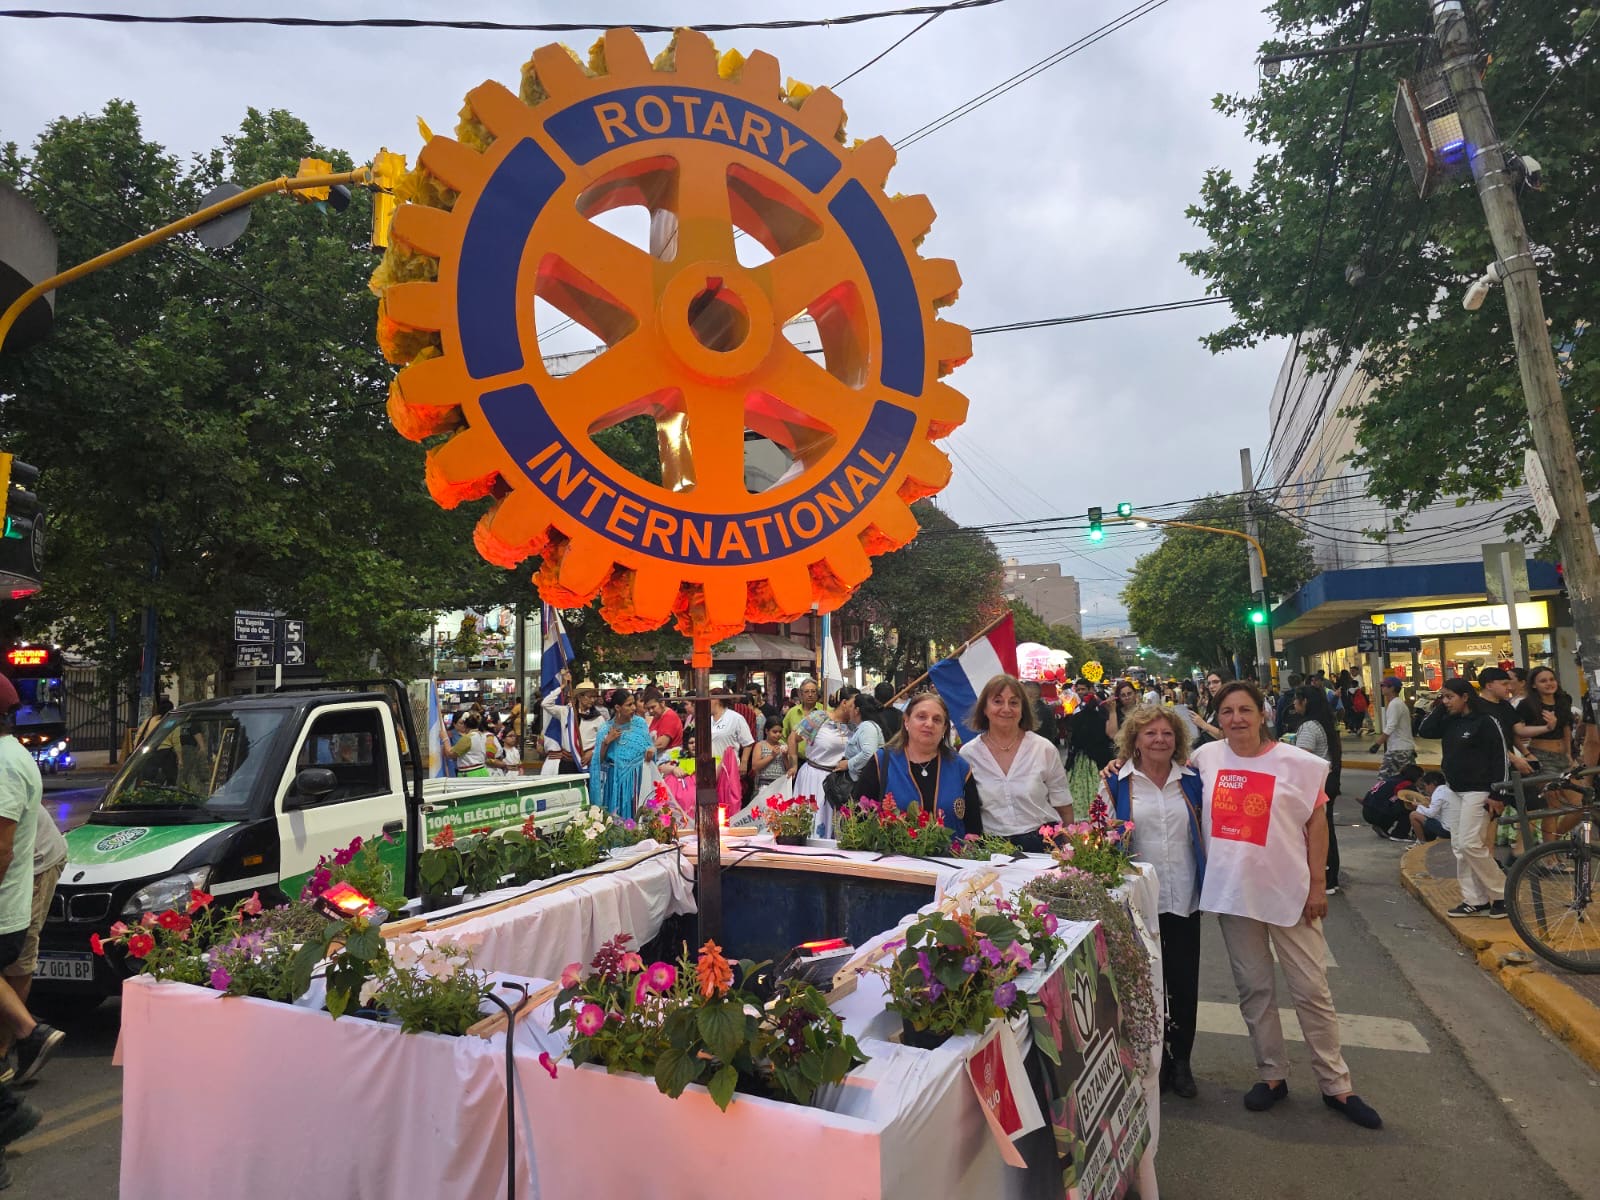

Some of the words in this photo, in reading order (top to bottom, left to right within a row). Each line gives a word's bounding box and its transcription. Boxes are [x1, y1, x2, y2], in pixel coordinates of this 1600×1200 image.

[593, 95, 808, 166] ROTARY
[526, 441, 896, 559] INTERNATIONAL
[1424, 609, 1499, 632] Coppel
[1218, 781, 1244, 789] PONER
[1220, 774, 1248, 783] QUIERO
[1214, 801, 1238, 812] POLIO
[427, 813, 463, 829] 100%
[50, 961, 71, 977] 001
[75, 962, 90, 978] BP
